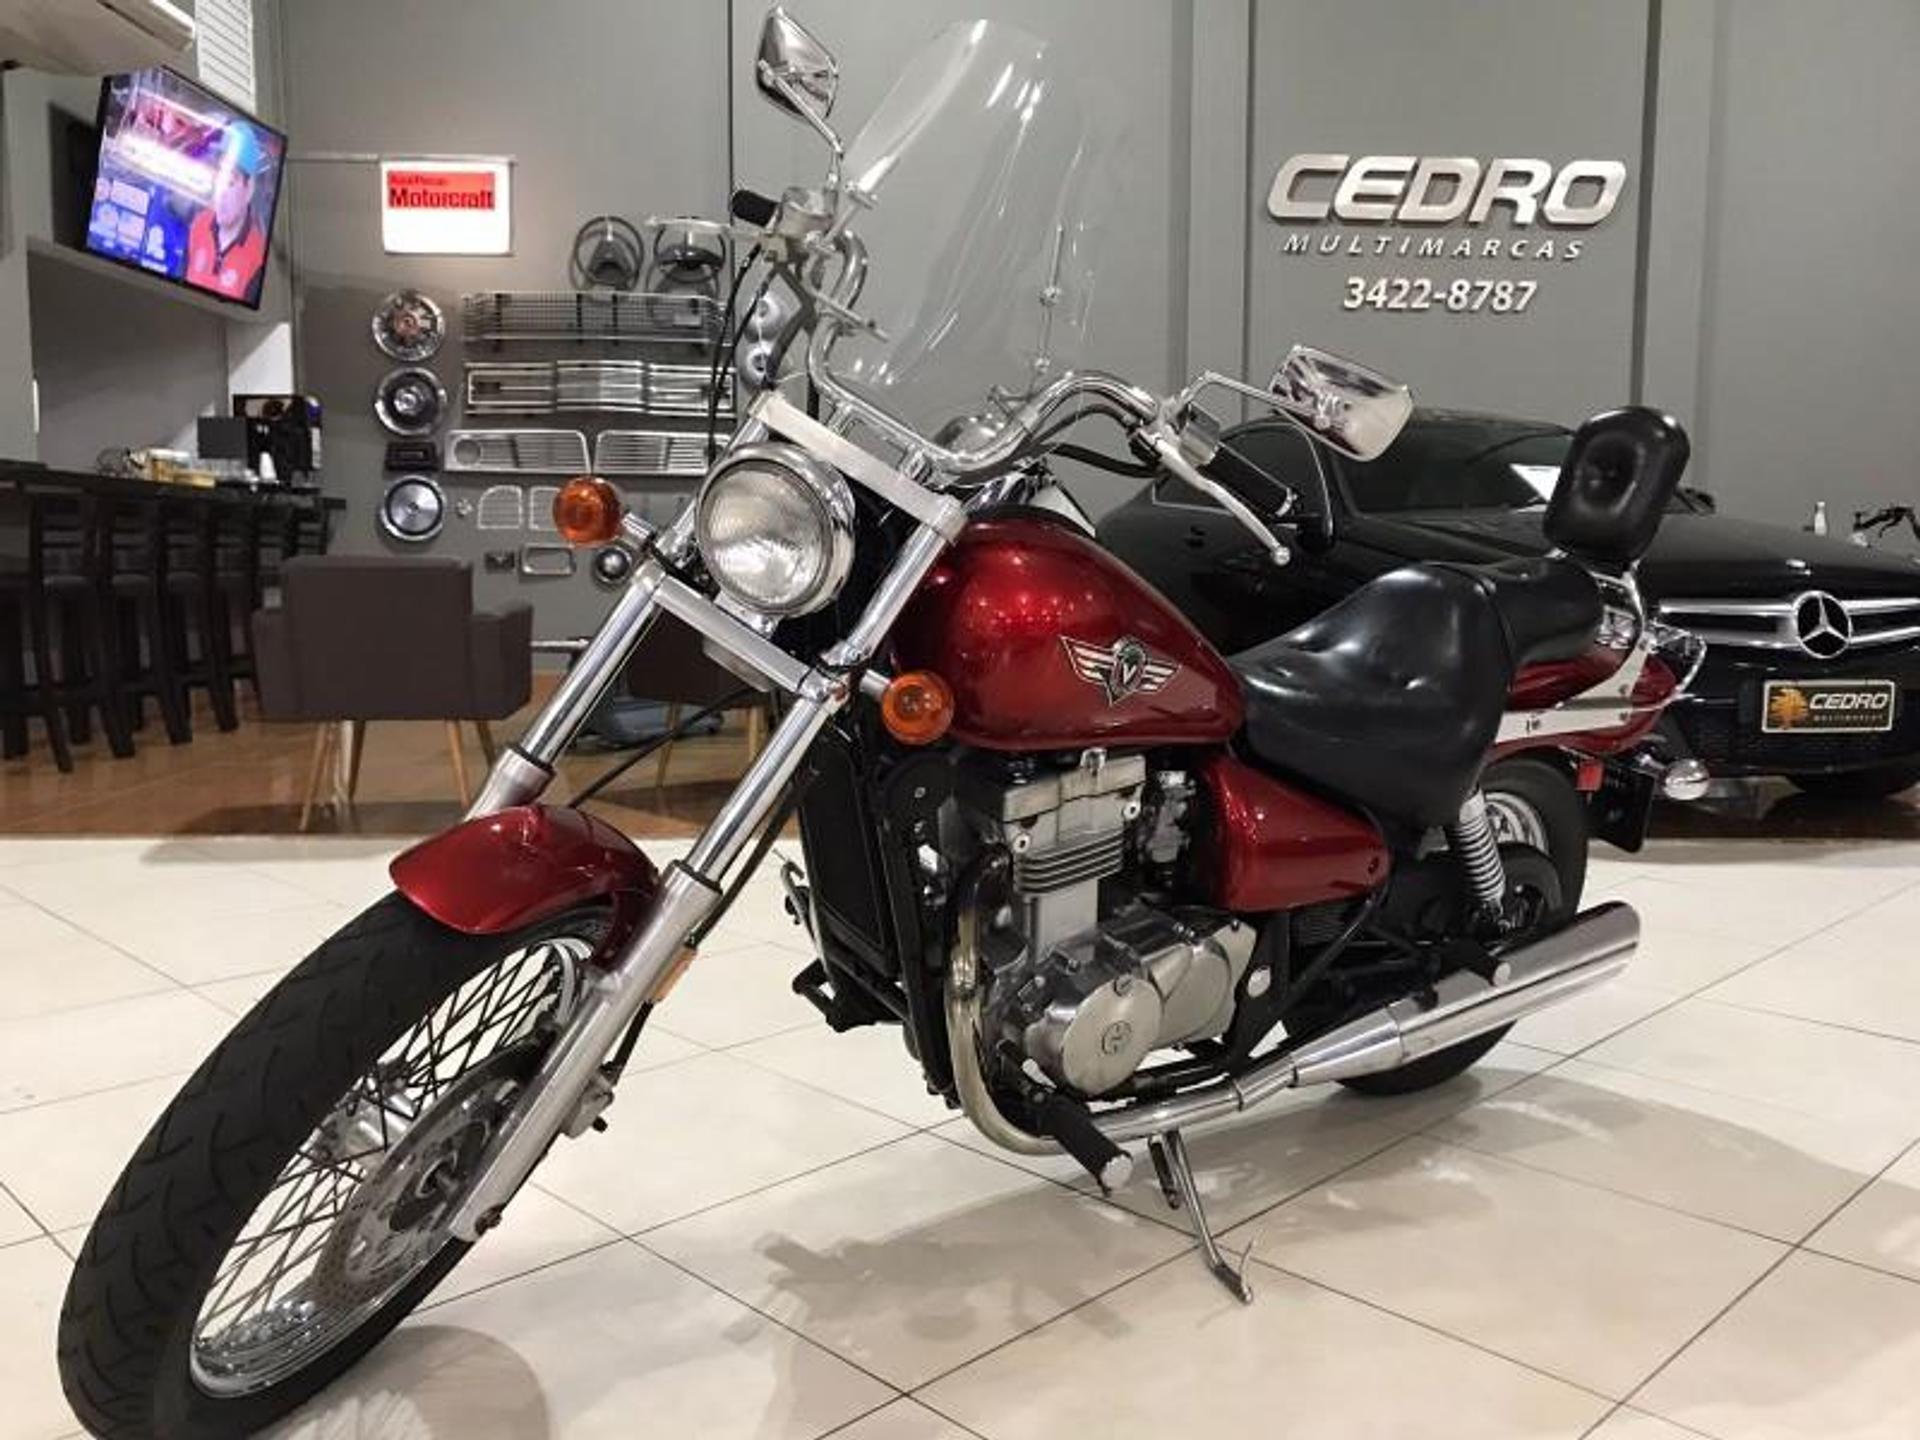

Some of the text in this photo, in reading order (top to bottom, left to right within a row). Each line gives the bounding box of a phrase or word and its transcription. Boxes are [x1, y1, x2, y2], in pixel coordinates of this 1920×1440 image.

[389, 187, 493, 209] Motorcraft
[1267, 153, 1627, 226] CEDRO
[1283, 233, 1585, 259] MULTIMARCAS
[1343, 276, 1538, 312] 3422-8787
[1809, 693, 1889, 709] CEDRO
